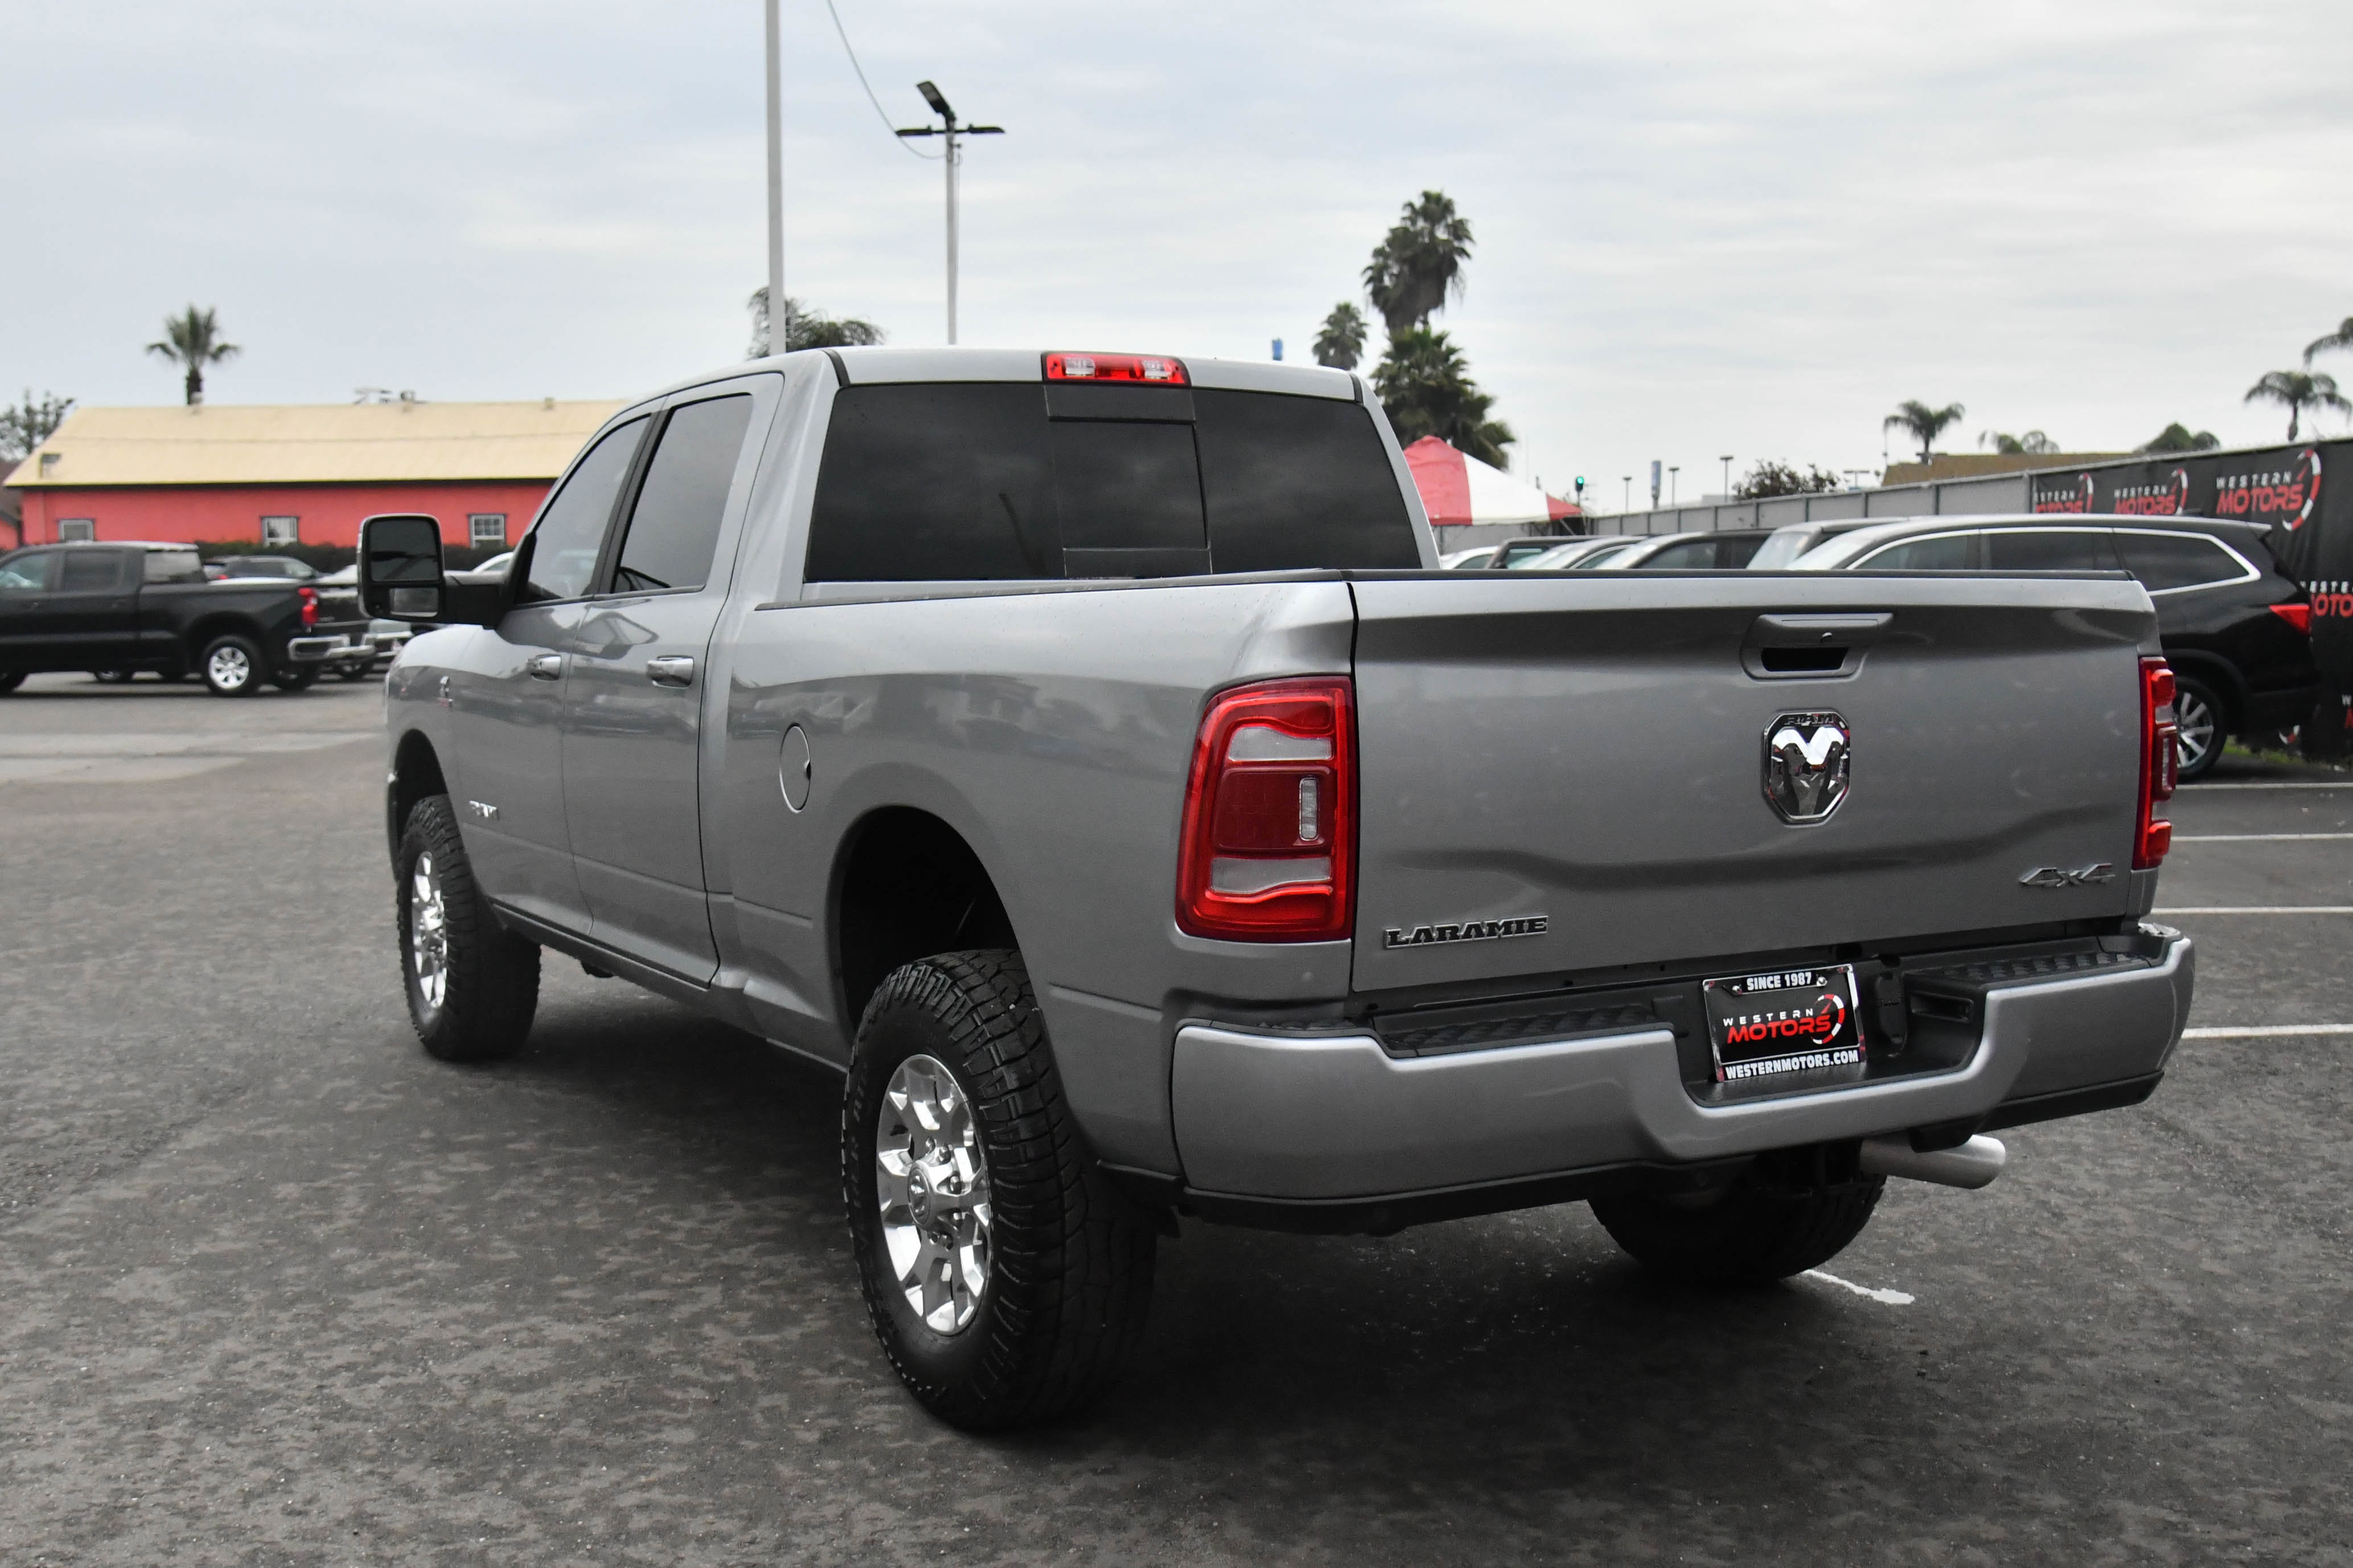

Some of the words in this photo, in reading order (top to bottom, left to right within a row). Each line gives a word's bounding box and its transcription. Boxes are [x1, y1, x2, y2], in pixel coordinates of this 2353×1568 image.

[2216, 471, 2292, 490] WESTERN
[2114, 484, 2167, 499] WESTERN
[2216, 483, 2304, 515] MOTORS
[2113, 494, 2175, 515] MOTORS
[2310, 592, 2353, 618] OTO
[1784, 715, 1835, 726] RAM
[1385, 915, 1549, 949] LARAMIE
[1747, 975, 1781, 991] SINCE
[1785, 972, 1812, 986] 1987
[1723, 1008, 1813, 1026] WESTERN
[1727, 1015, 1831, 1044] MOTORS
[1725, 1050, 1859, 1080] WESTERNMOTORS.COM
